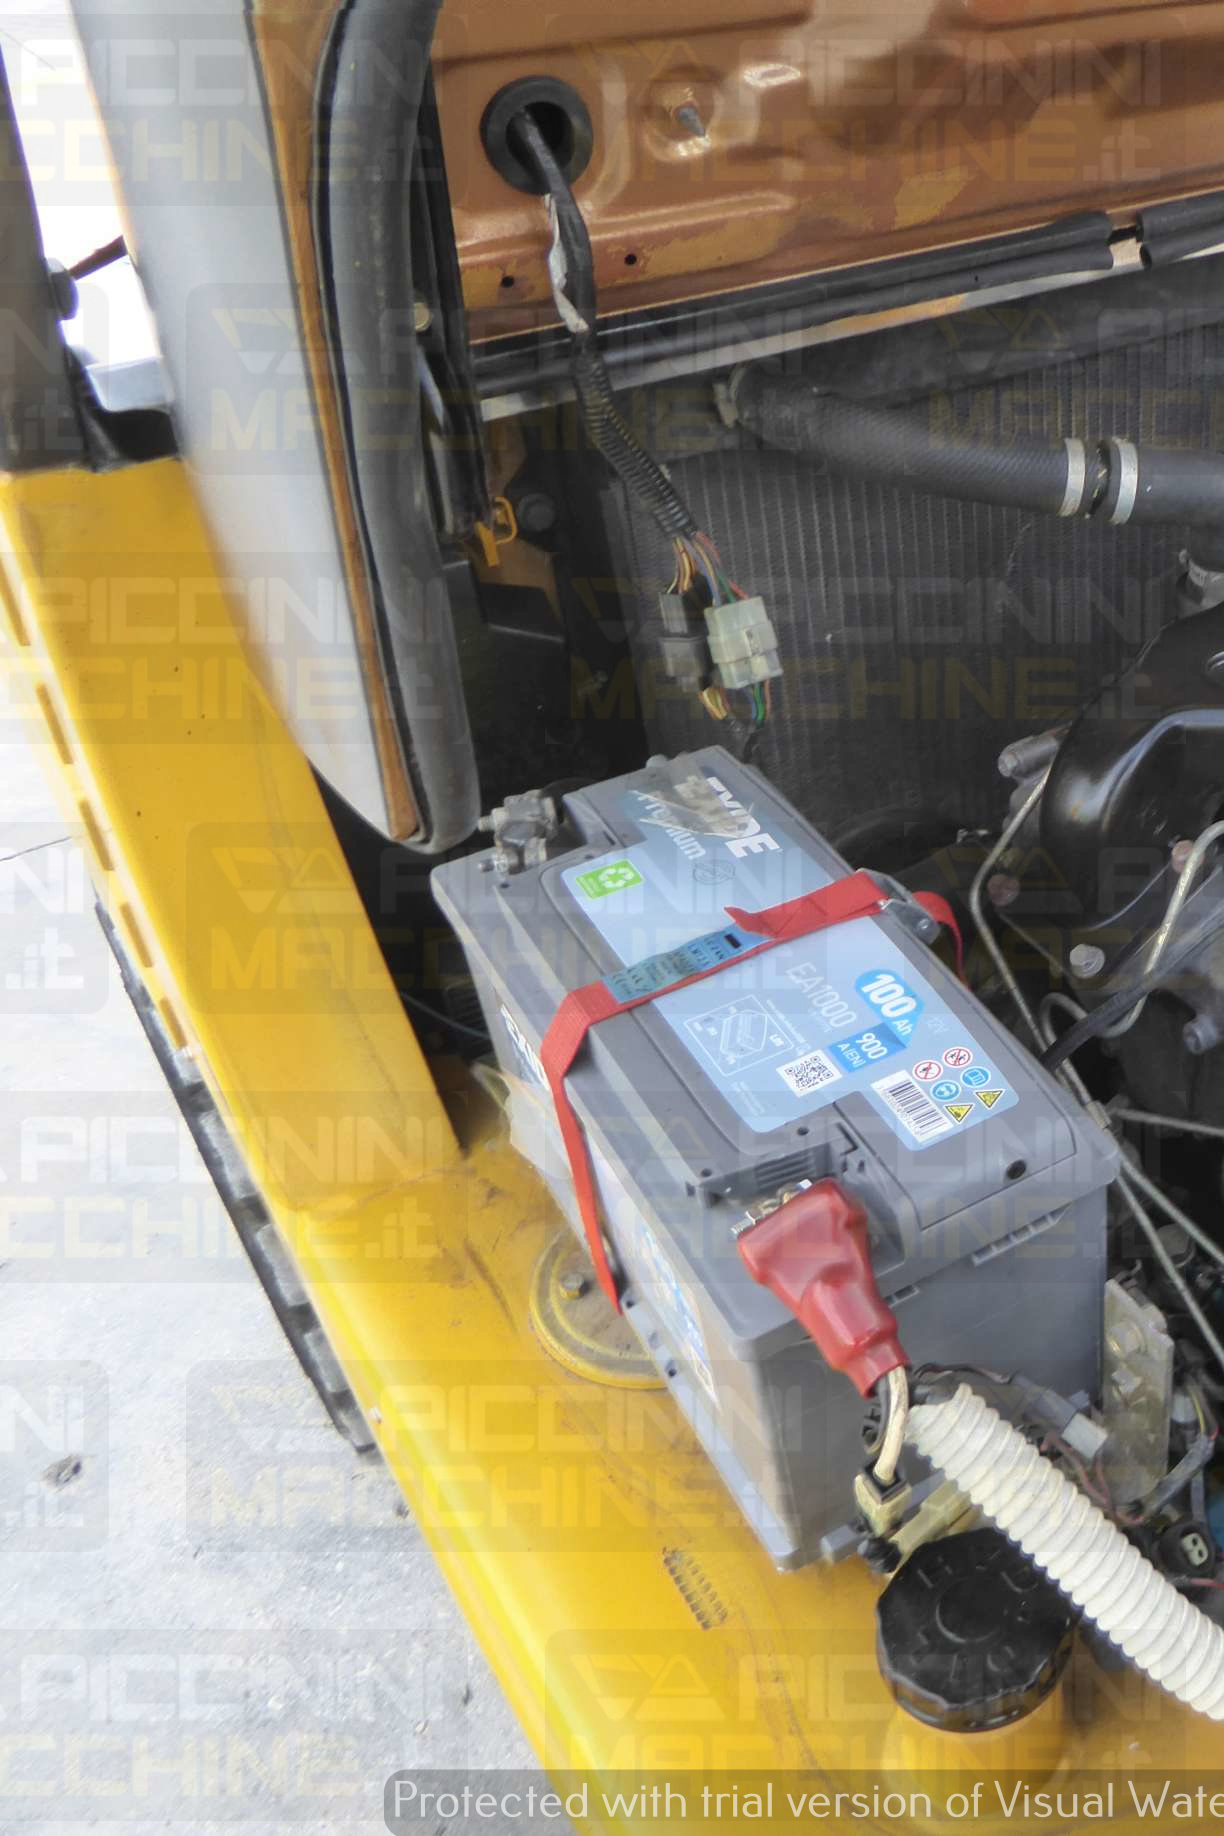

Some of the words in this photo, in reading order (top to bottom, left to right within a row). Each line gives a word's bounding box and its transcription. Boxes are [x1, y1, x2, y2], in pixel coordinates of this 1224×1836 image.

[786, 962, 856, 1028] EA1000
[861, 974, 917, 1018] 100
[893, 1019, 912, 1036] Ah
[856, 1032, 888, 1060] 900
